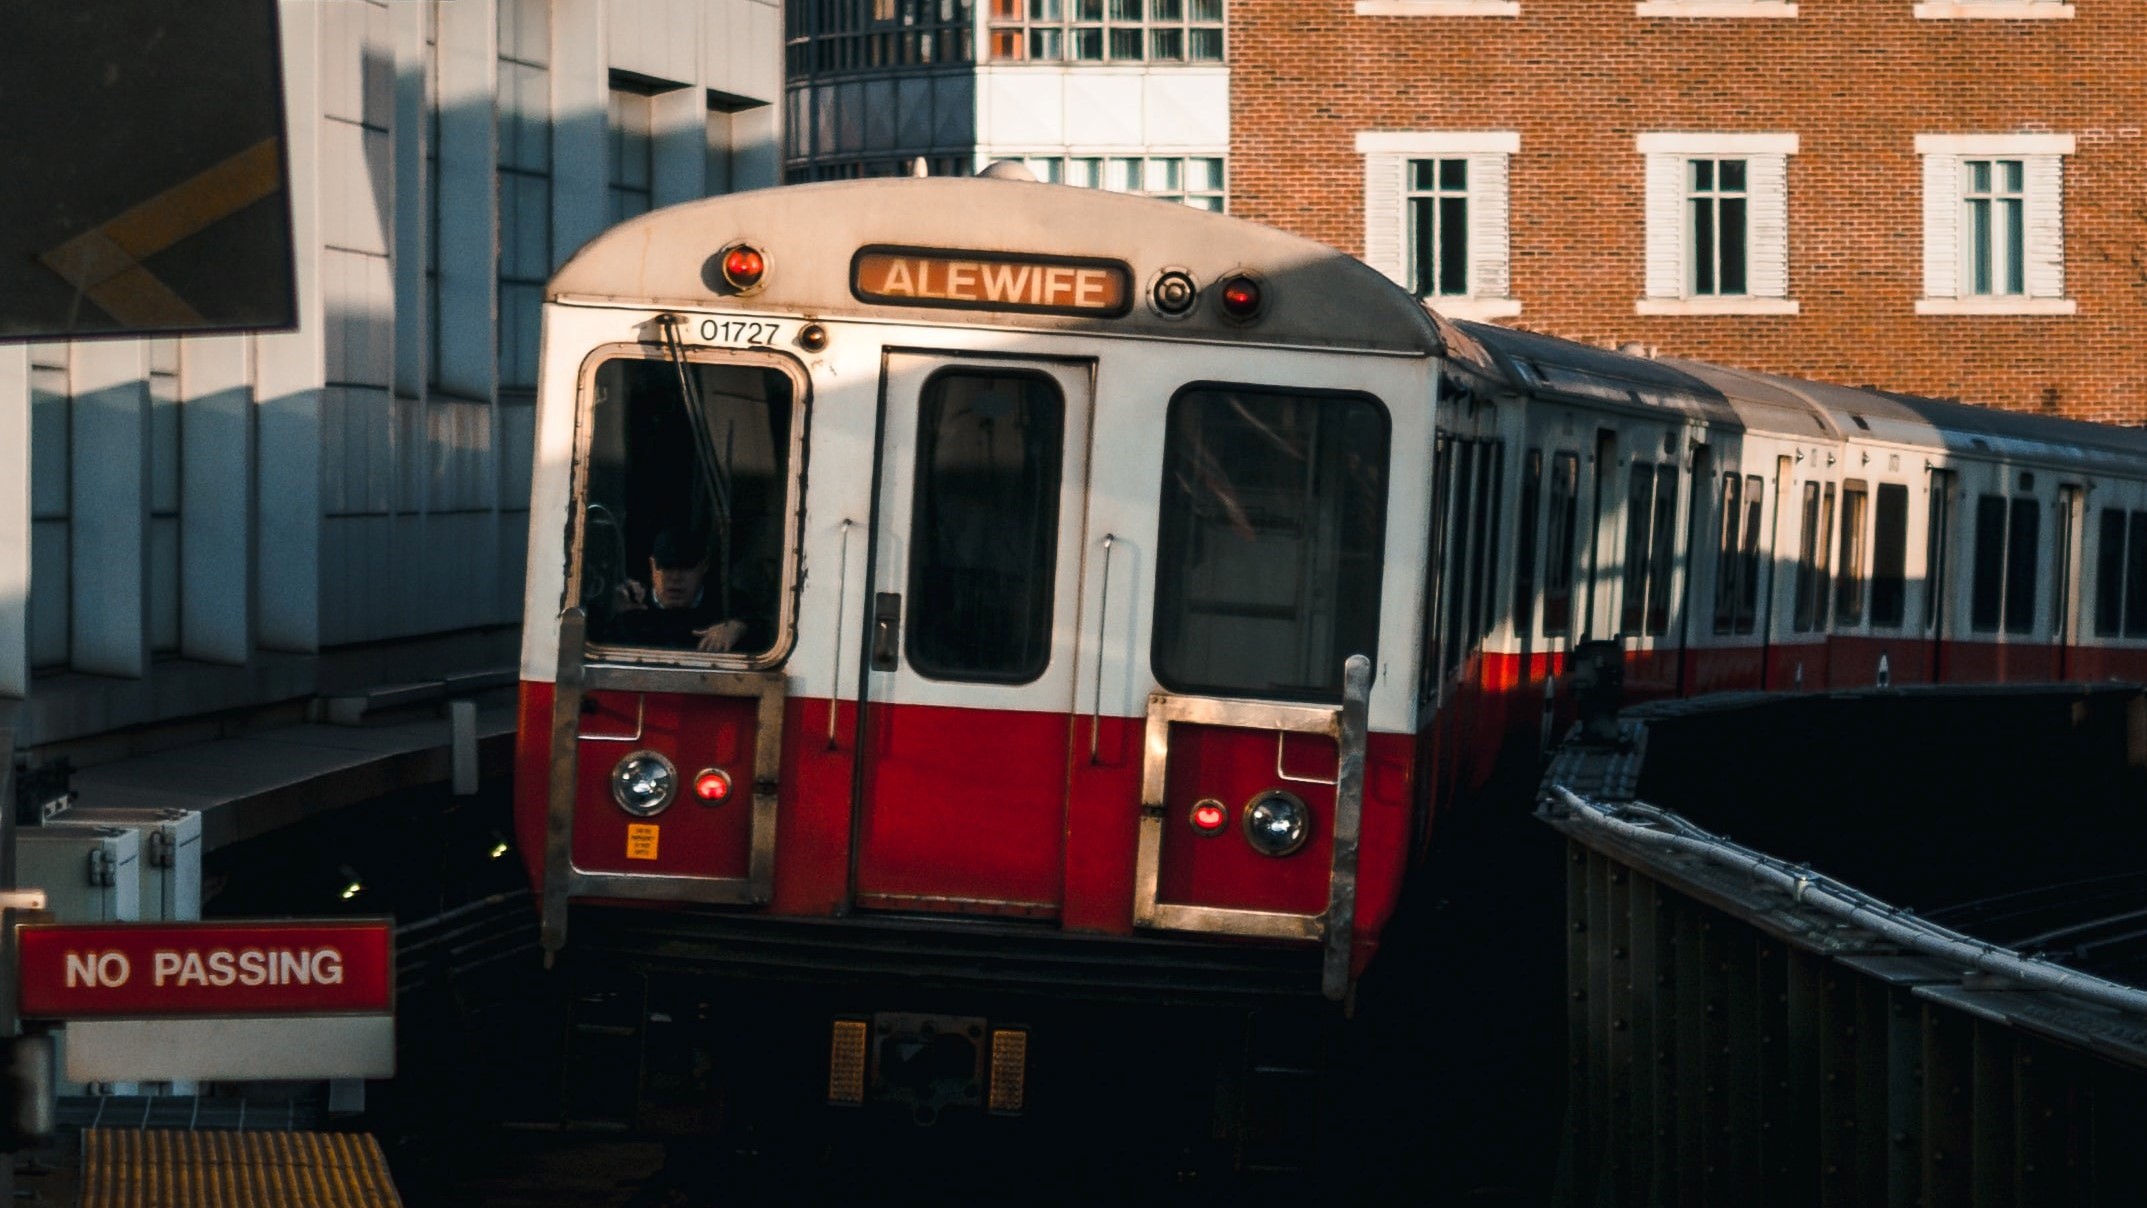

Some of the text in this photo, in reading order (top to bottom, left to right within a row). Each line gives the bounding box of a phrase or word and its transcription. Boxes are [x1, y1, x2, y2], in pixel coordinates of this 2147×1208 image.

[883, 258, 1107, 308] ALEWIFE
[700, 319, 780, 345] 01727
[66, 949, 343, 987] NO PASSING
